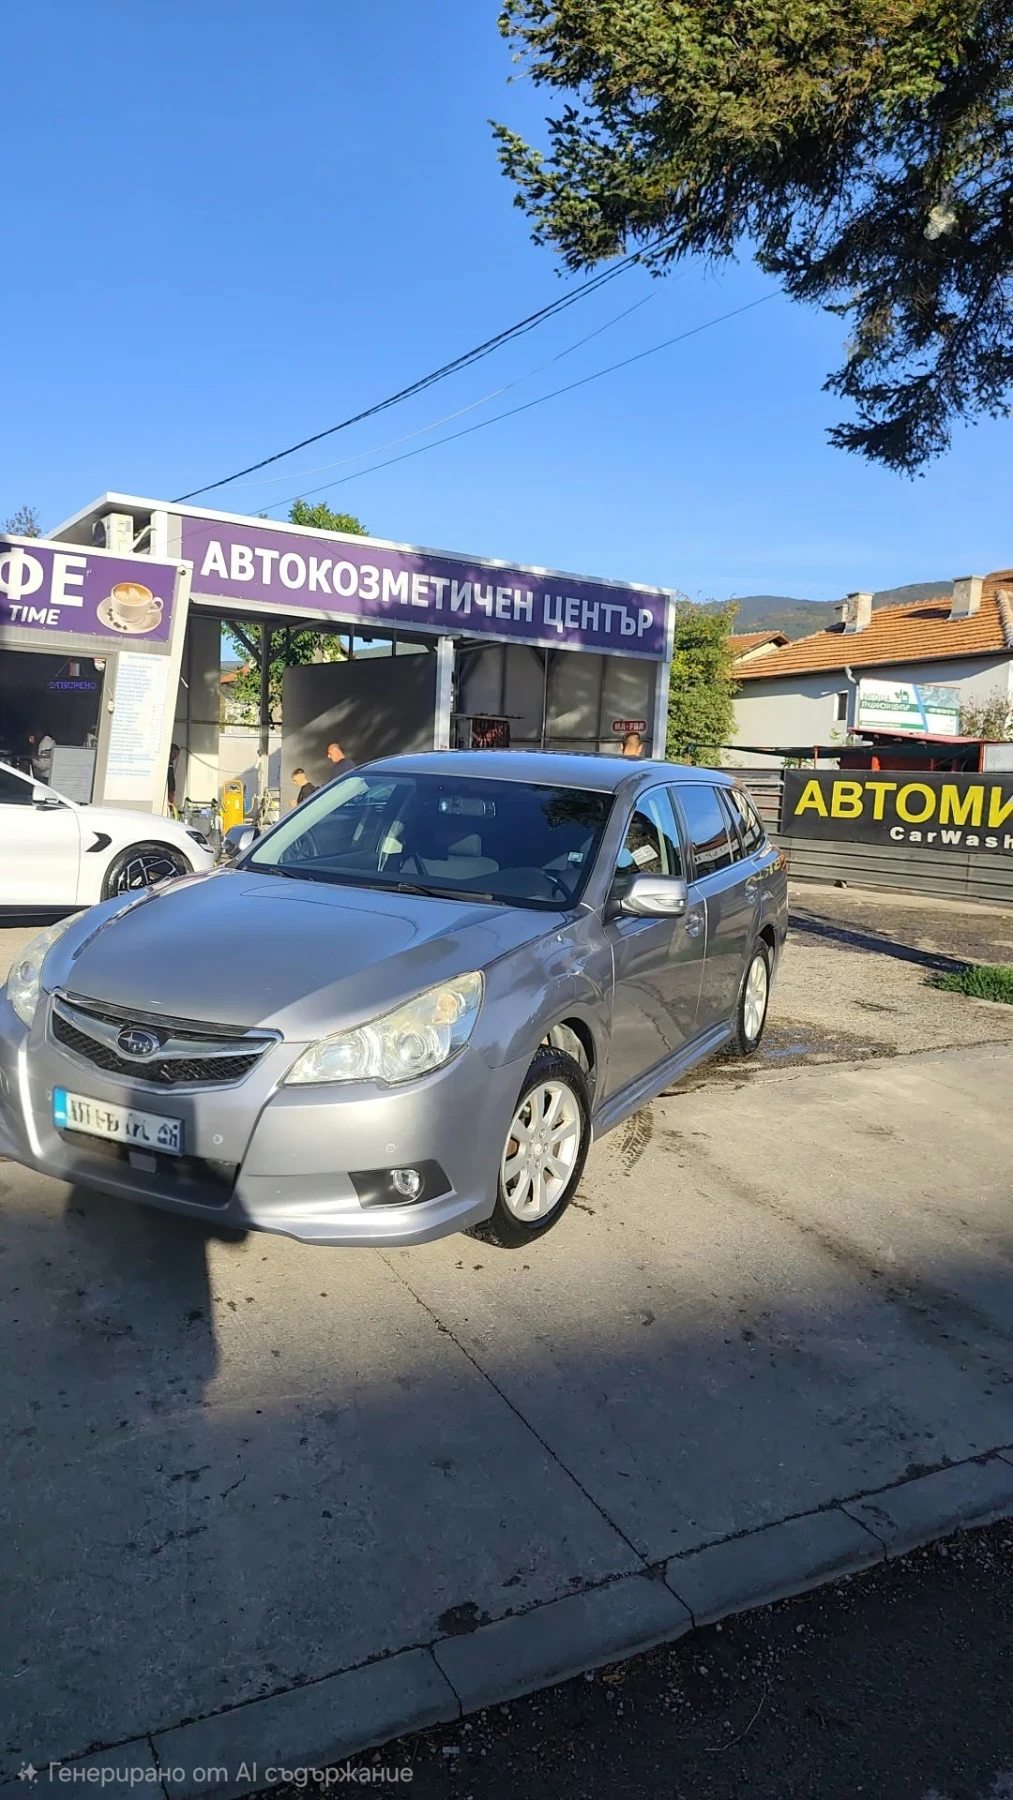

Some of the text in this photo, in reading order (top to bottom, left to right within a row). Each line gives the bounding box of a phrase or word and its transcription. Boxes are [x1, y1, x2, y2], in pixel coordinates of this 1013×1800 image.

[0, 547, 87, 607] ФЕ
[200, 540, 654, 638] АВТОКОЗМЕТИЧЕН ЦЕНТЪР
[9, 604, 61, 625] TIME
